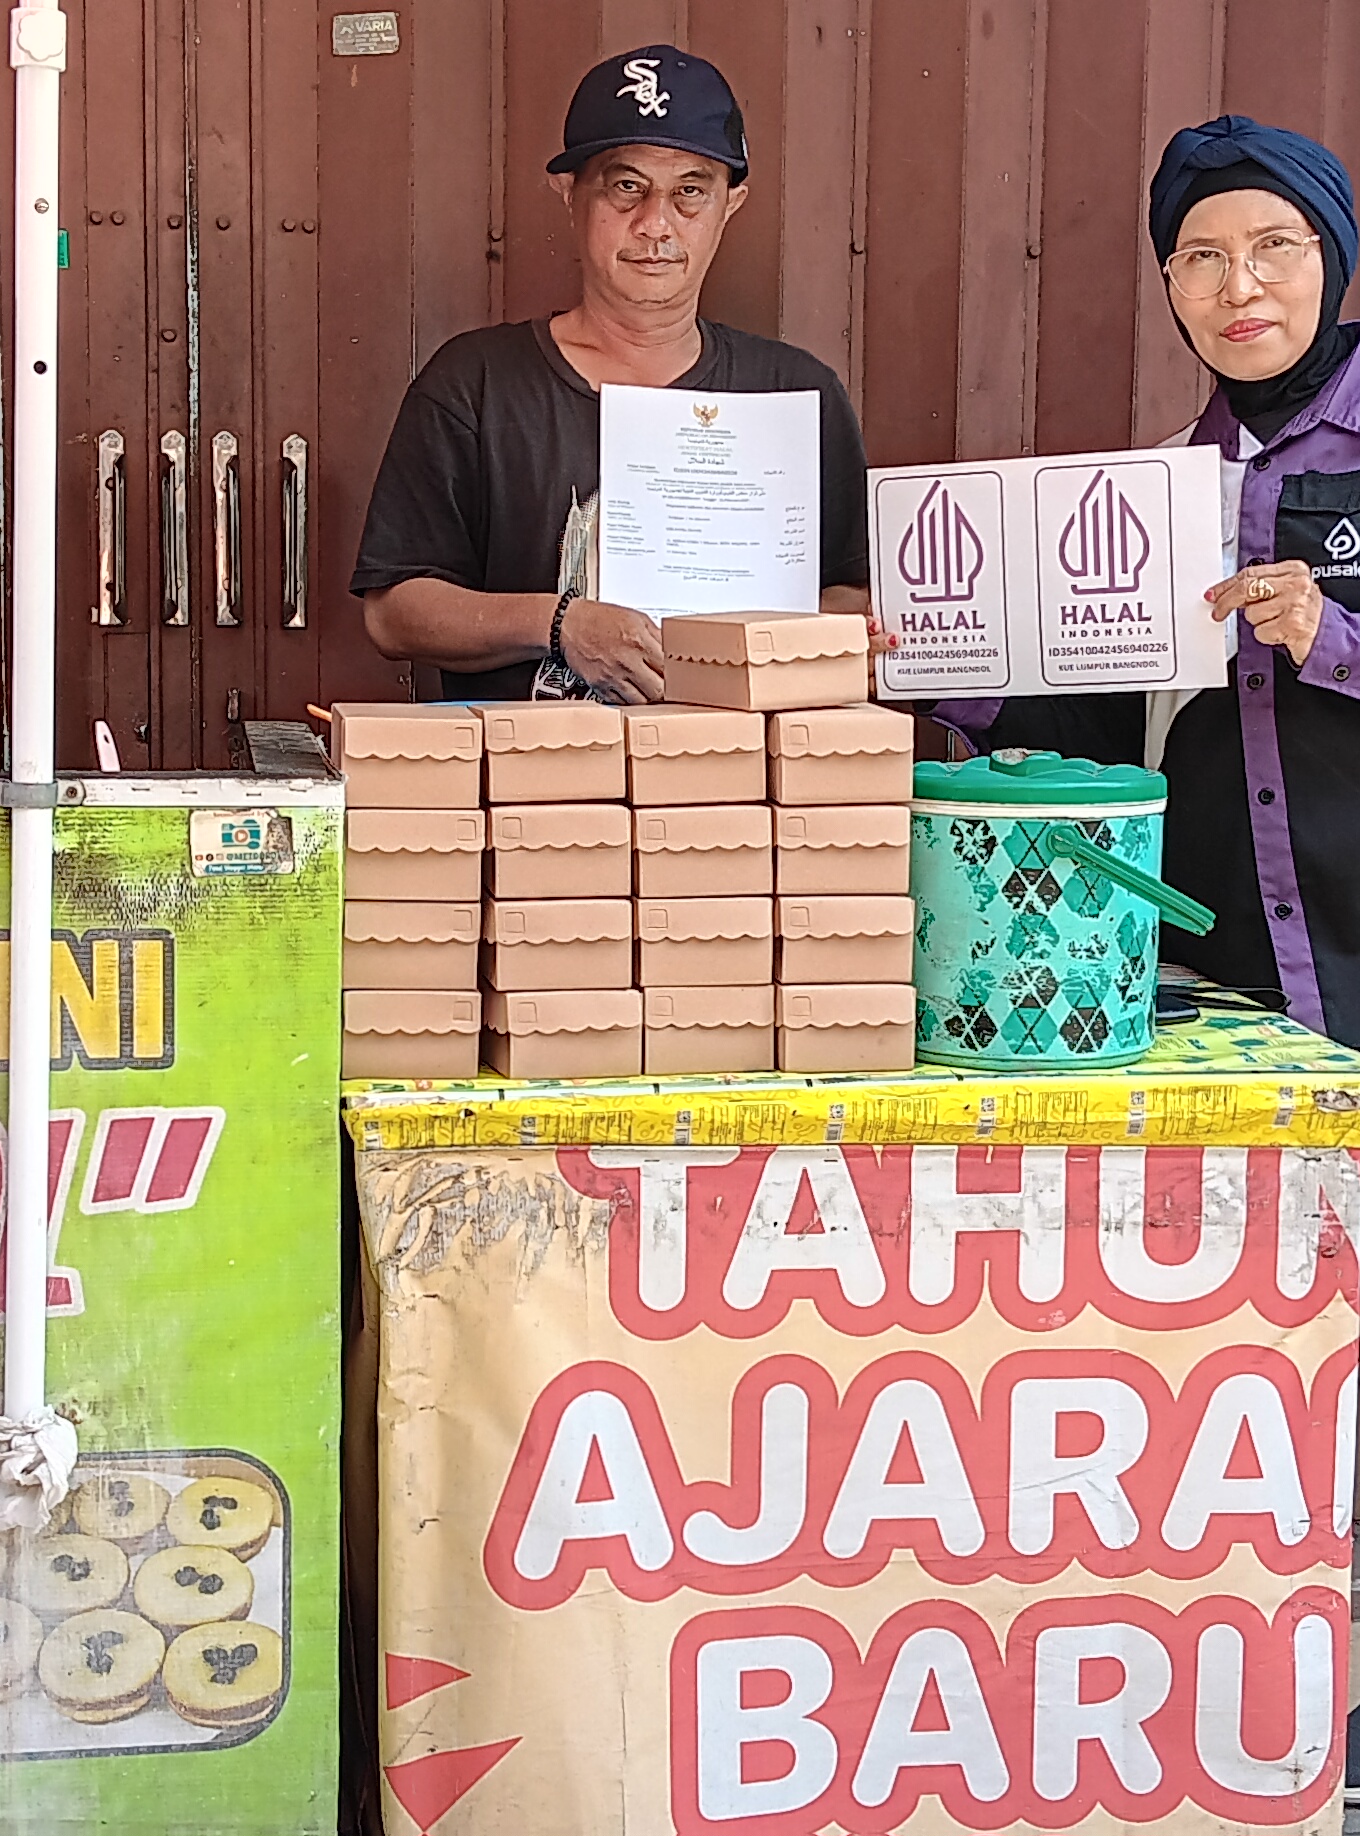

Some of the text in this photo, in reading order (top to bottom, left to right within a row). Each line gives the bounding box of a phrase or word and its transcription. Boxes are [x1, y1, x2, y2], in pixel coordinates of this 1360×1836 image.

[900, 611, 986, 632] HALAL
[1061, 602, 1152, 625] HALAL
[903, 634, 986, 645] INDONESIA
[1061, 627, 1152, 638] INDONESIA
[913, 667, 945, 675] LUMPUR
[1058, 661, 1160, 672] KUE LUMPUR BANGNDOL
[514, 1373, 1359, 1581] AJARA
[696, 1614, 1334, 1822] BARU
